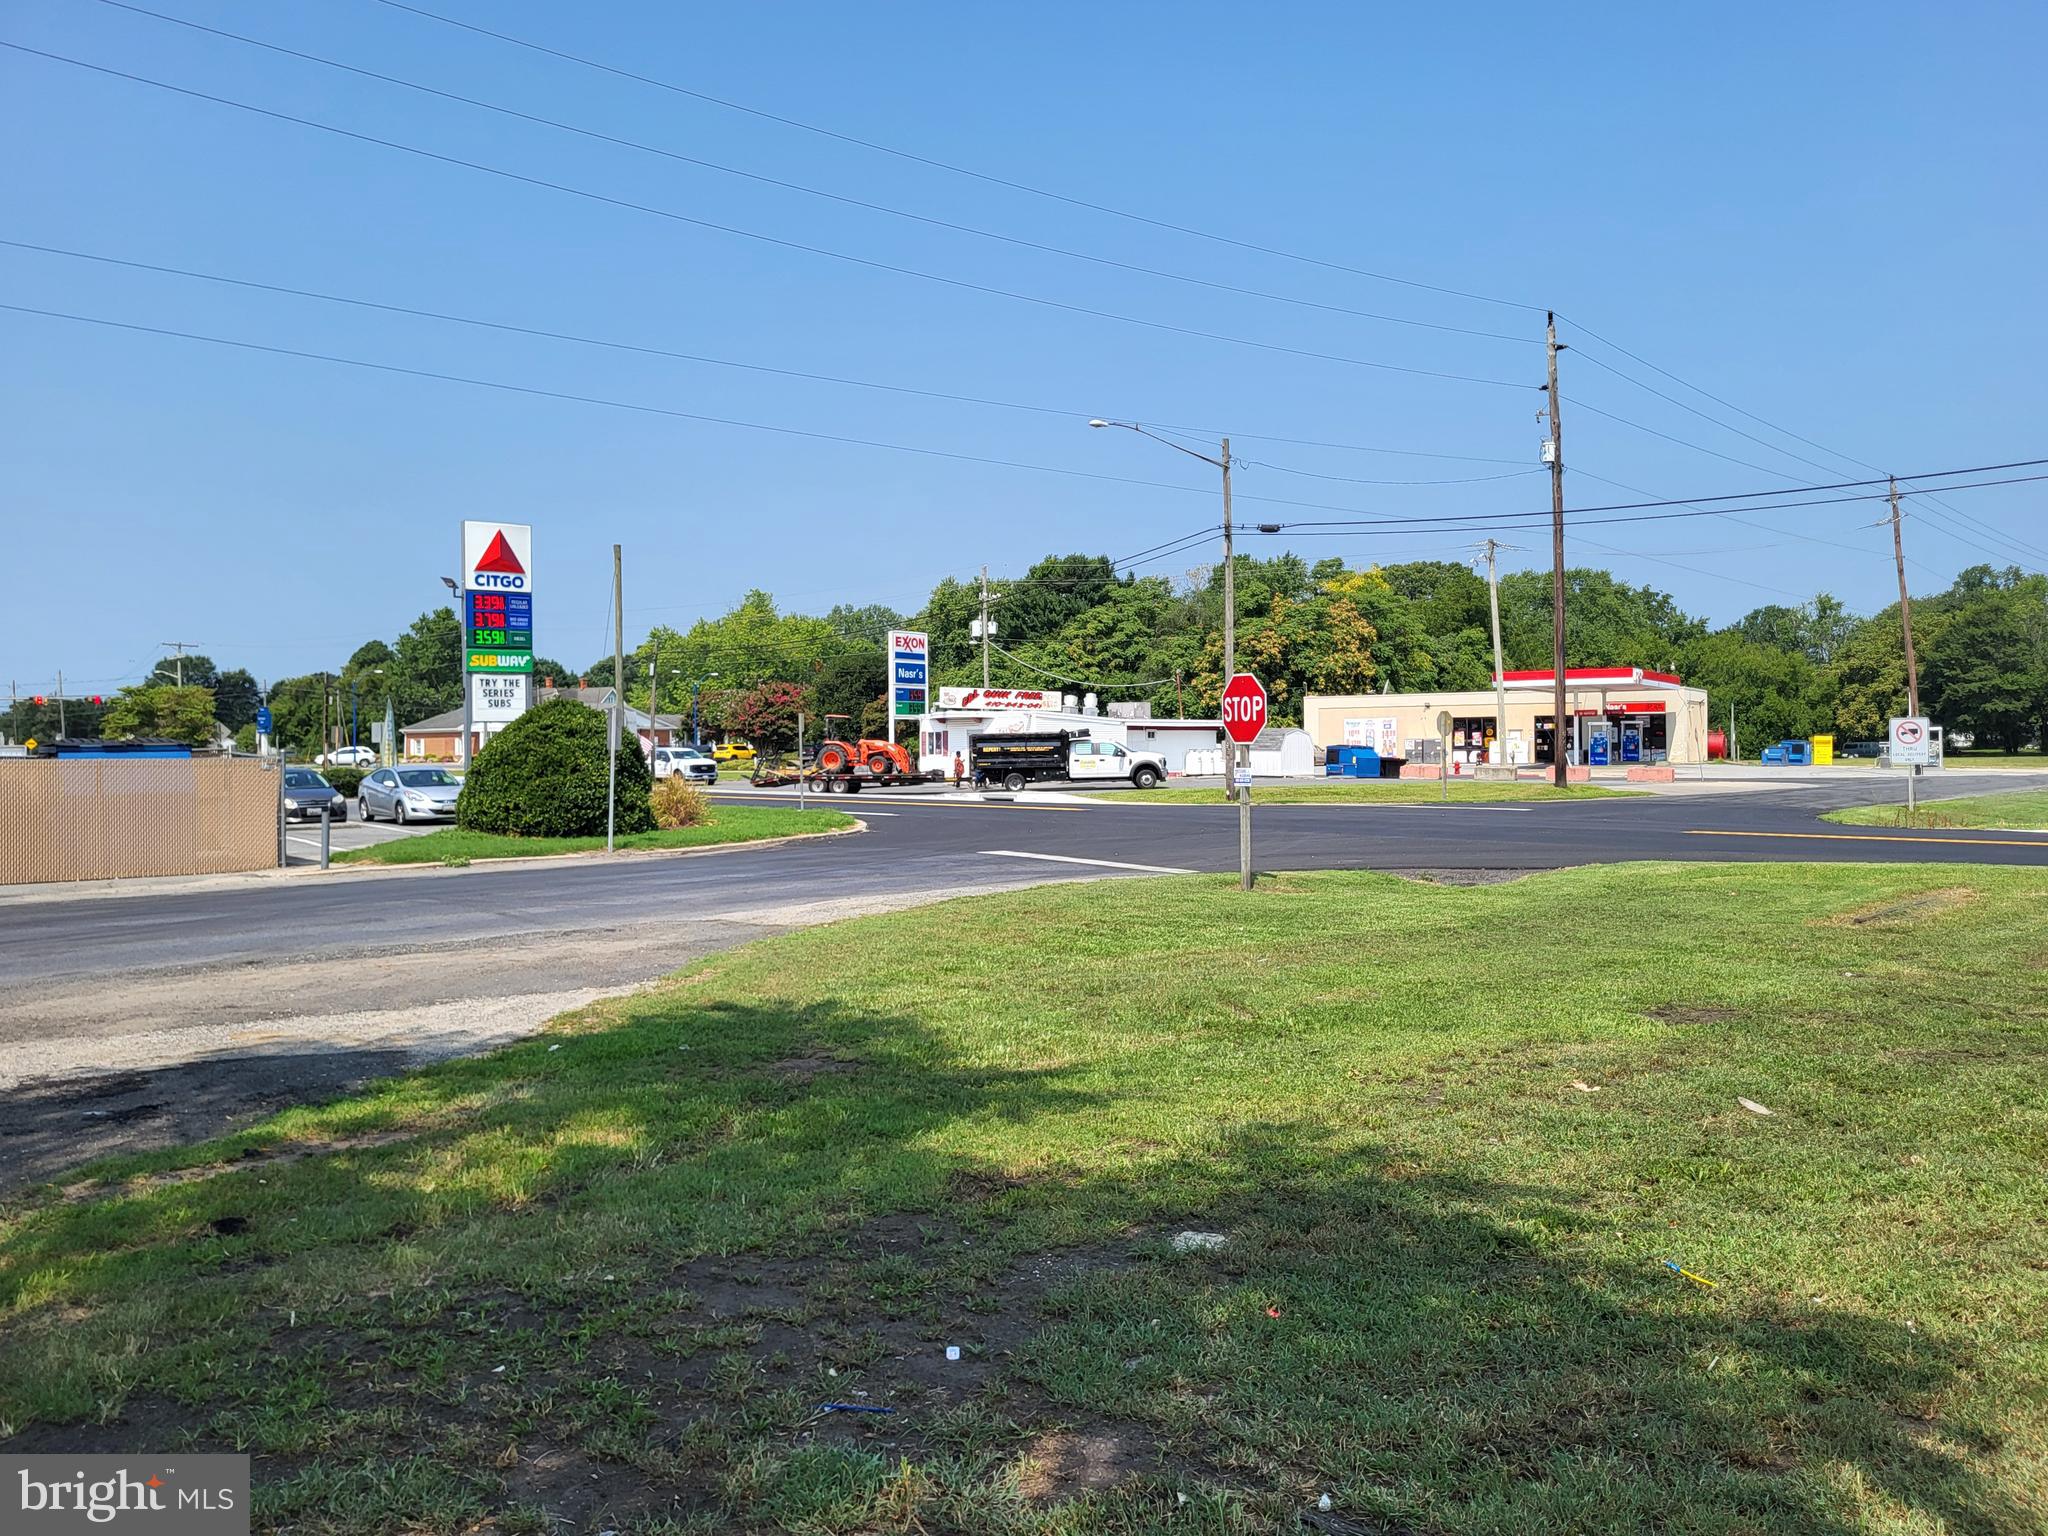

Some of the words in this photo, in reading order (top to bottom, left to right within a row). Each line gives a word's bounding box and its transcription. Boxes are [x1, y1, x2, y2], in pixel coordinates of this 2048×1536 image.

[475, 574, 524, 588] CITGO
[895, 636, 925, 652] EXXON
[469, 654, 531, 667] SUBWAY
[898, 668, 923, 679] Nasr's
[480, 678, 497, 687] TRY
[503, 679, 521, 688] THE
[483, 688, 515, 697] SERIES
[488, 698, 512, 708] SUBS
[1224, 695, 1263, 722] STOP
